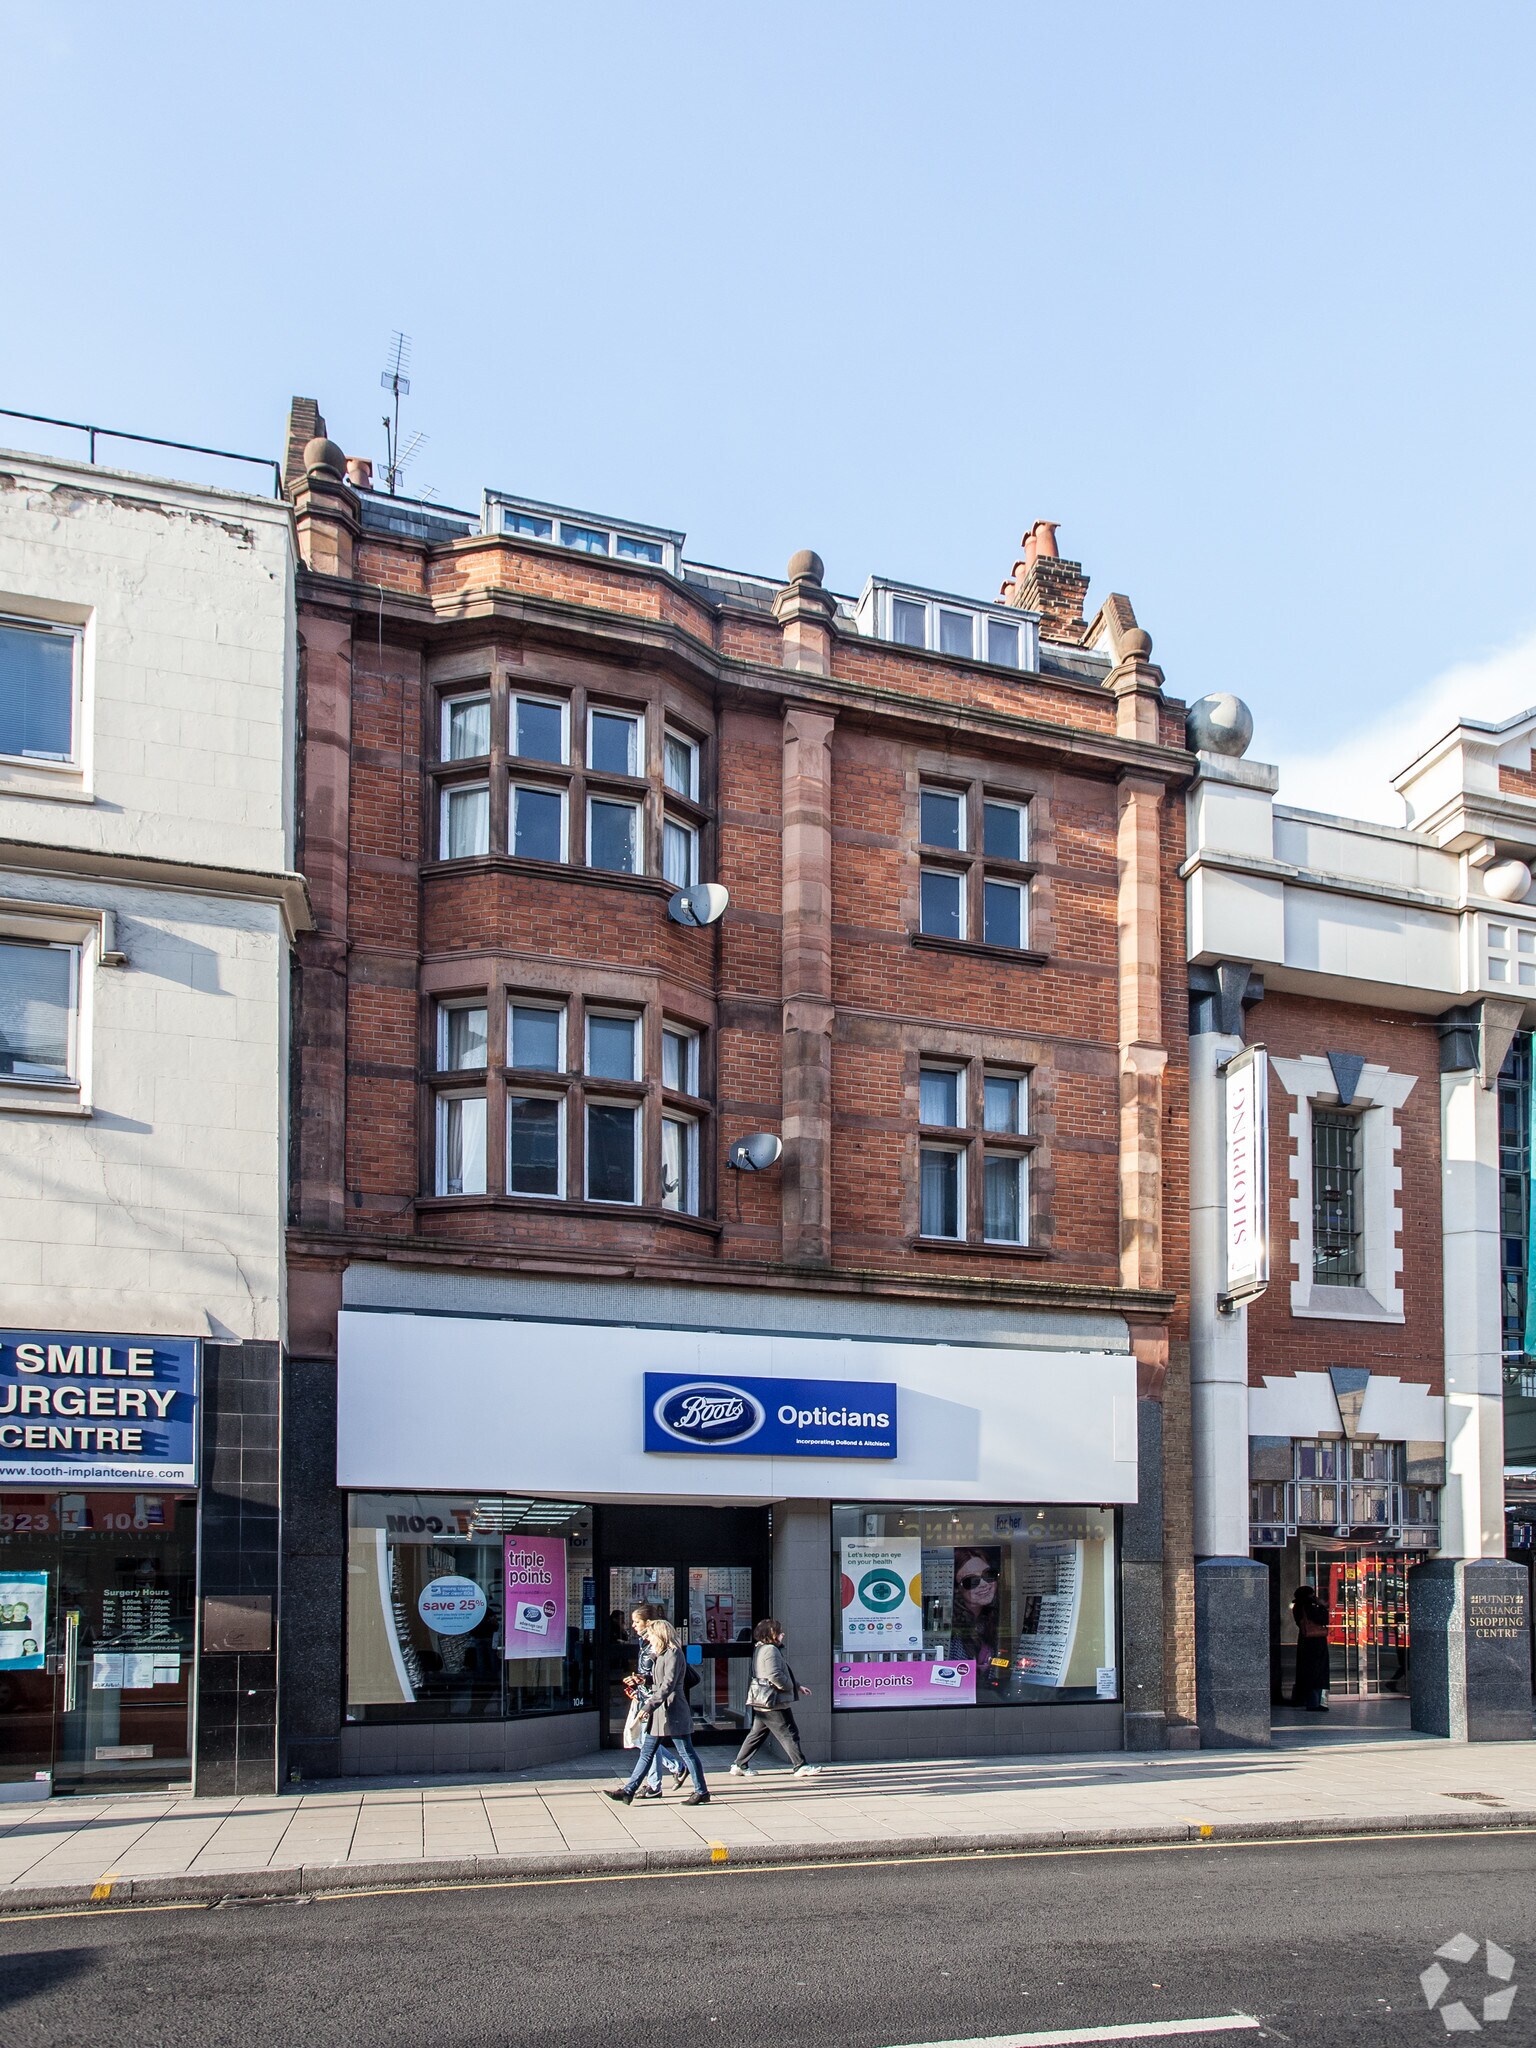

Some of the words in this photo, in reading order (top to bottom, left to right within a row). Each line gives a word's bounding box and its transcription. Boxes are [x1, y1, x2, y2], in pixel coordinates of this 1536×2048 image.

[15, 1343, 155, 1377] SMILE
[673, 1396, 744, 1429] Boots
[777, 1405, 890, 1428] Opticians
[0, 1424, 143, 1451] CENTRE
[796, 1438, 835, 1446] Incorporating
[0, 1466, 184, 1478] www.tooth-implantcentre.com
[103, 1513, 148, 1530] 106
[568, 1535, 588, 1547] for
[508, 1550, 545, 1570] triple
[508, 1568, 552, 1587] points
[103, 1589, 140, 1598] Surgery
[1478, 1595, 1515, 1604] PUTNEY
[422, 1601, 456, 1611] save
[459, 1599, 485, 1610] 25%
[1471, 1606, 1523, 1615] EXCHANGE
[1469, 1617, 1523, 1627] SHOPPING
[1475, 1628, 1518, 1638] CENTRE
[838, 1676, 872, 1689] triple
[874, 1675, 914, 1689] points
[572, 1697, 584, 1707] 104
